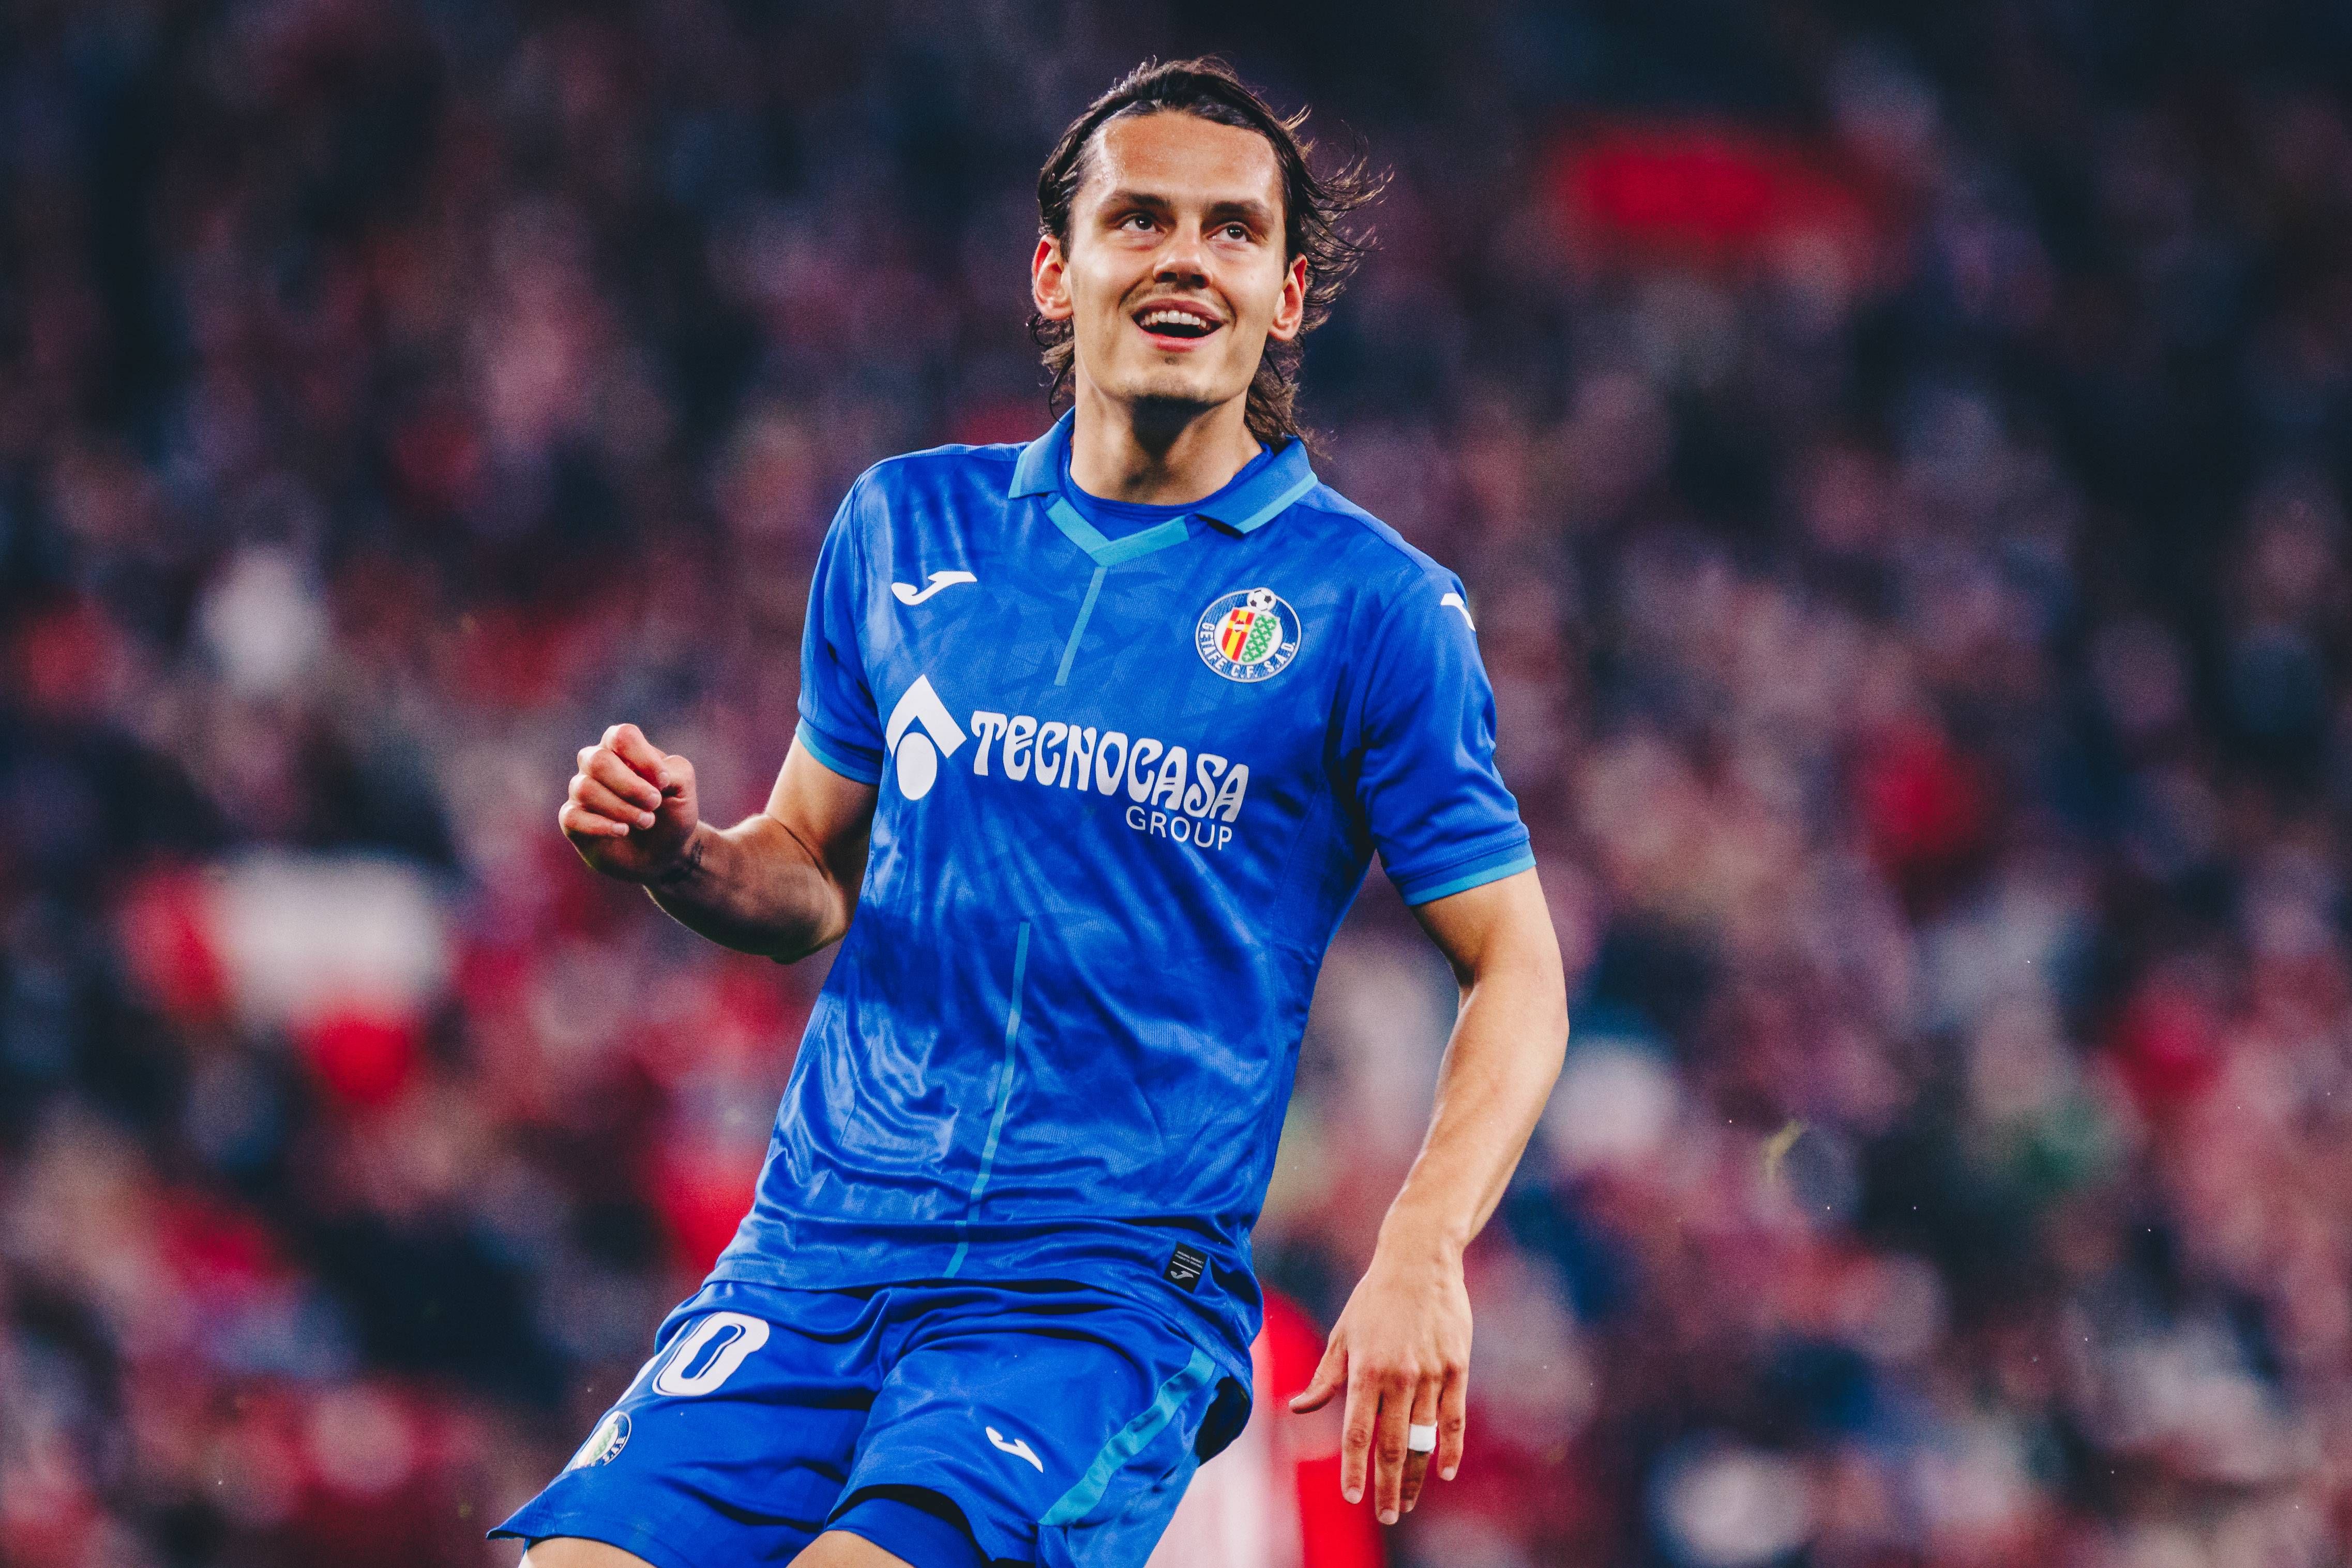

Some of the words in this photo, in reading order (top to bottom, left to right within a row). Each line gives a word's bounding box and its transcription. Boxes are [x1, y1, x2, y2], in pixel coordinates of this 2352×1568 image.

[1200, 623, 1227, 669] GETAFE
[1231, 665, 1258, 679] C.F.
[971, 711, 1249, 822] TECNOCASA
[1126, 806, 1232, 850] GROUP
